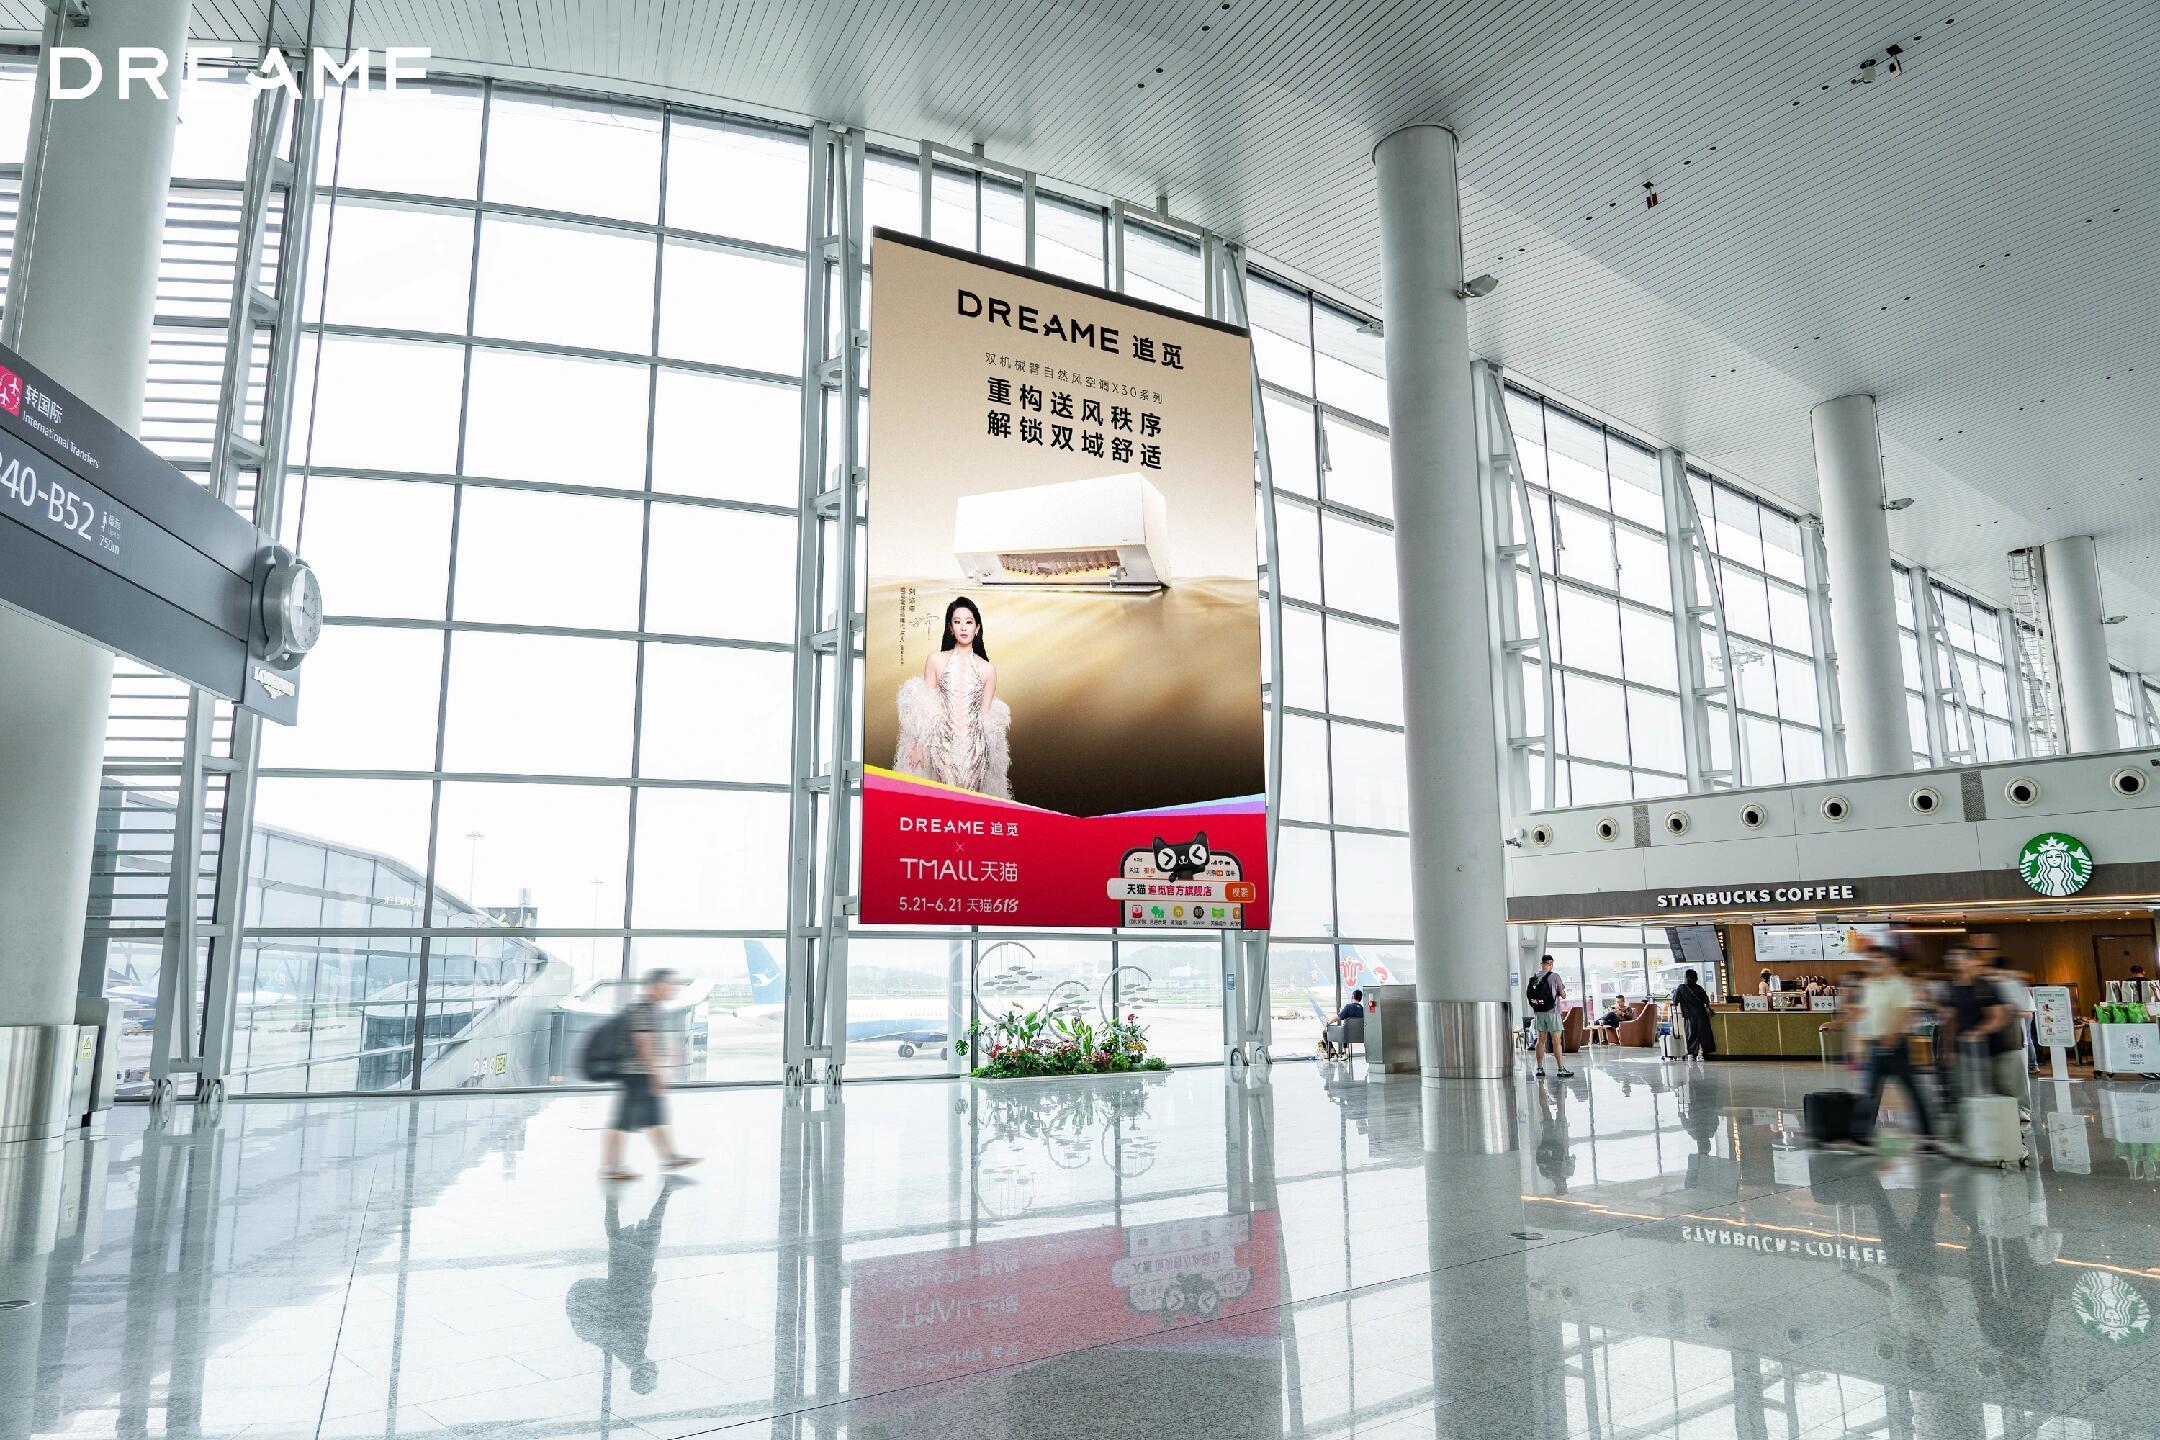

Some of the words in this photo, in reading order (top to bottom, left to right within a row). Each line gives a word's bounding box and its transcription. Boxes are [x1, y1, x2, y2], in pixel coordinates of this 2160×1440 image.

[957, 288, 1119, 354] DREAME
[1132, 335, 1184, 370] 追觅
[25, 383, 64, 424] 转国际
[987, 376, 1162, 438] 重构送风秩序
[22, 410, 69, 449] International
[70, 441, 100, 469] Transfers
[987, 409, 1162, 470] 解锁双域舒适
[0, 451, 95, 541] 40-B52
[900, 816, 984, 835] DREAME
[990, 821, 1019, 837] 追觅
[899, 896, 962, 912] 5.21-6.21
[1127, 883, 1146, 895] 天猫
[1657, 888, 1771, 907] STARBUCKS
[1775, 885, 1854, 902] COFFEE
